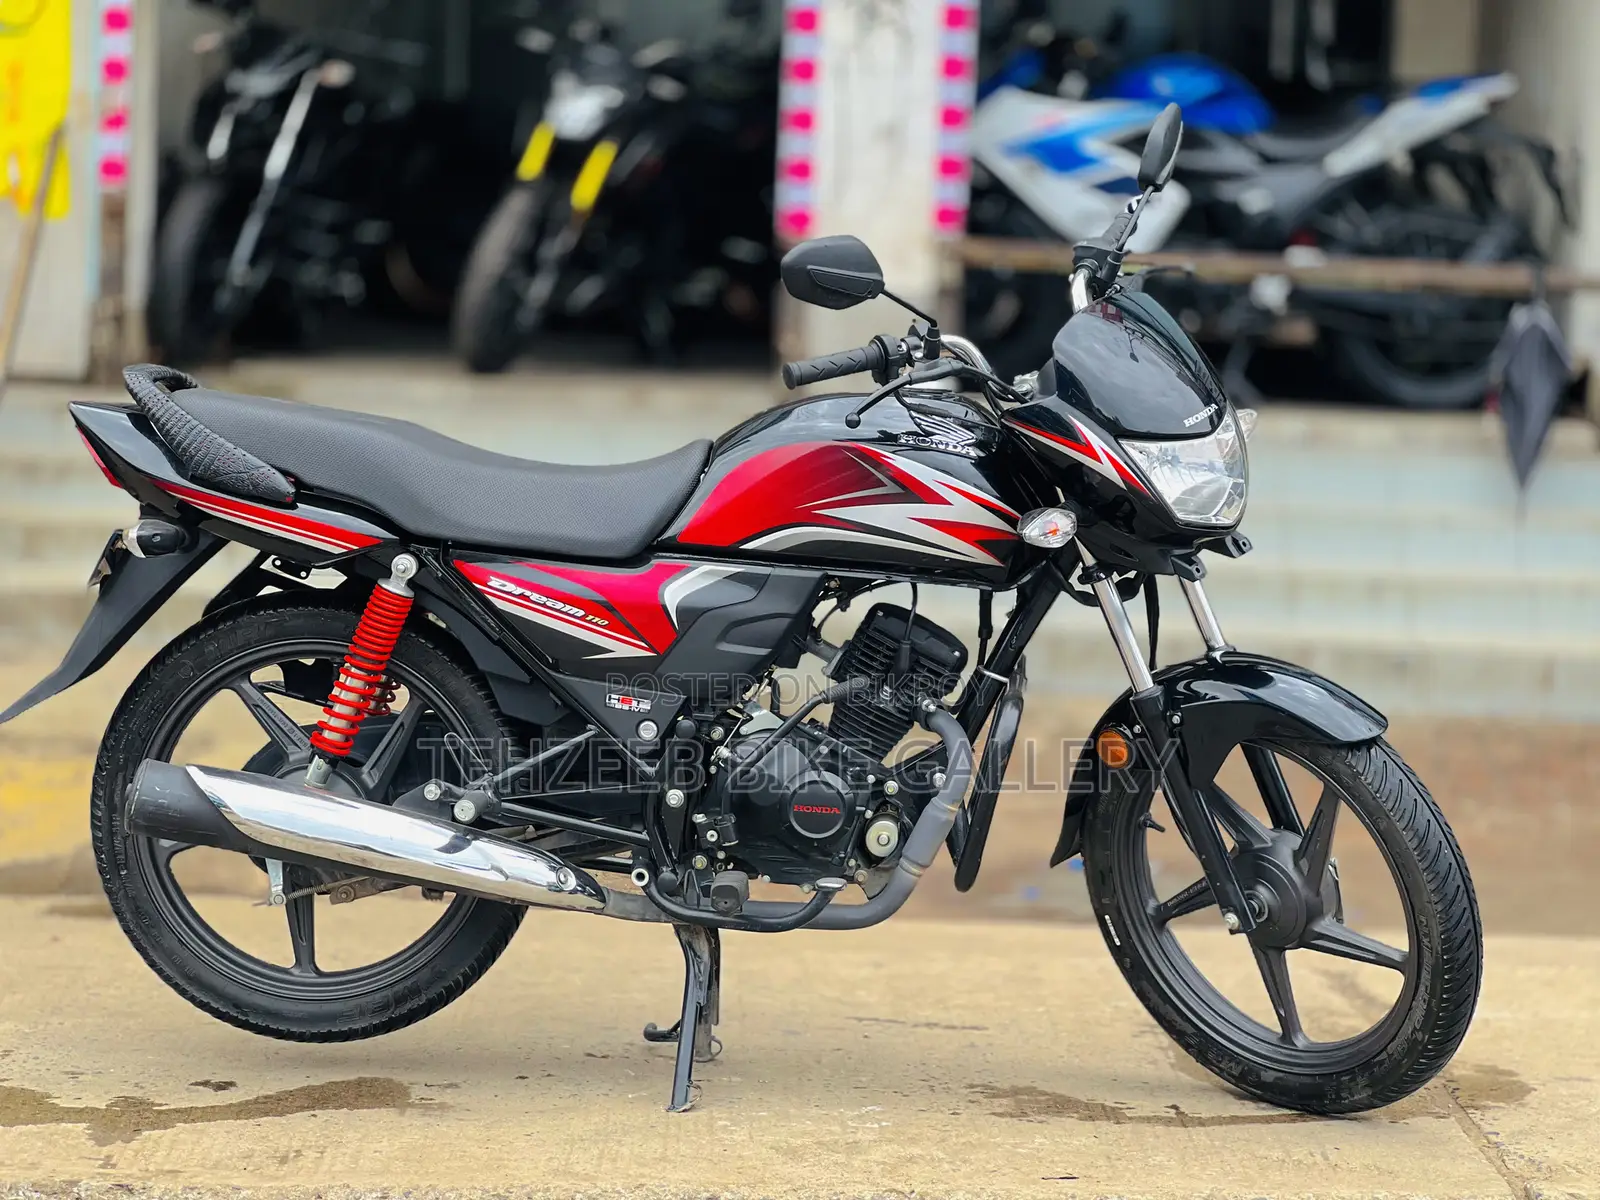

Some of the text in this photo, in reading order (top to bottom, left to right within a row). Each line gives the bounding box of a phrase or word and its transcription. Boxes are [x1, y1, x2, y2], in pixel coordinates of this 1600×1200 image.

[1183, 403, 1219, 428] HONDA
[897, 433, 979, 460] HONDA
[487, 575, 612, 627] Dream 110
[793, 804, 841, 814] HONDA
